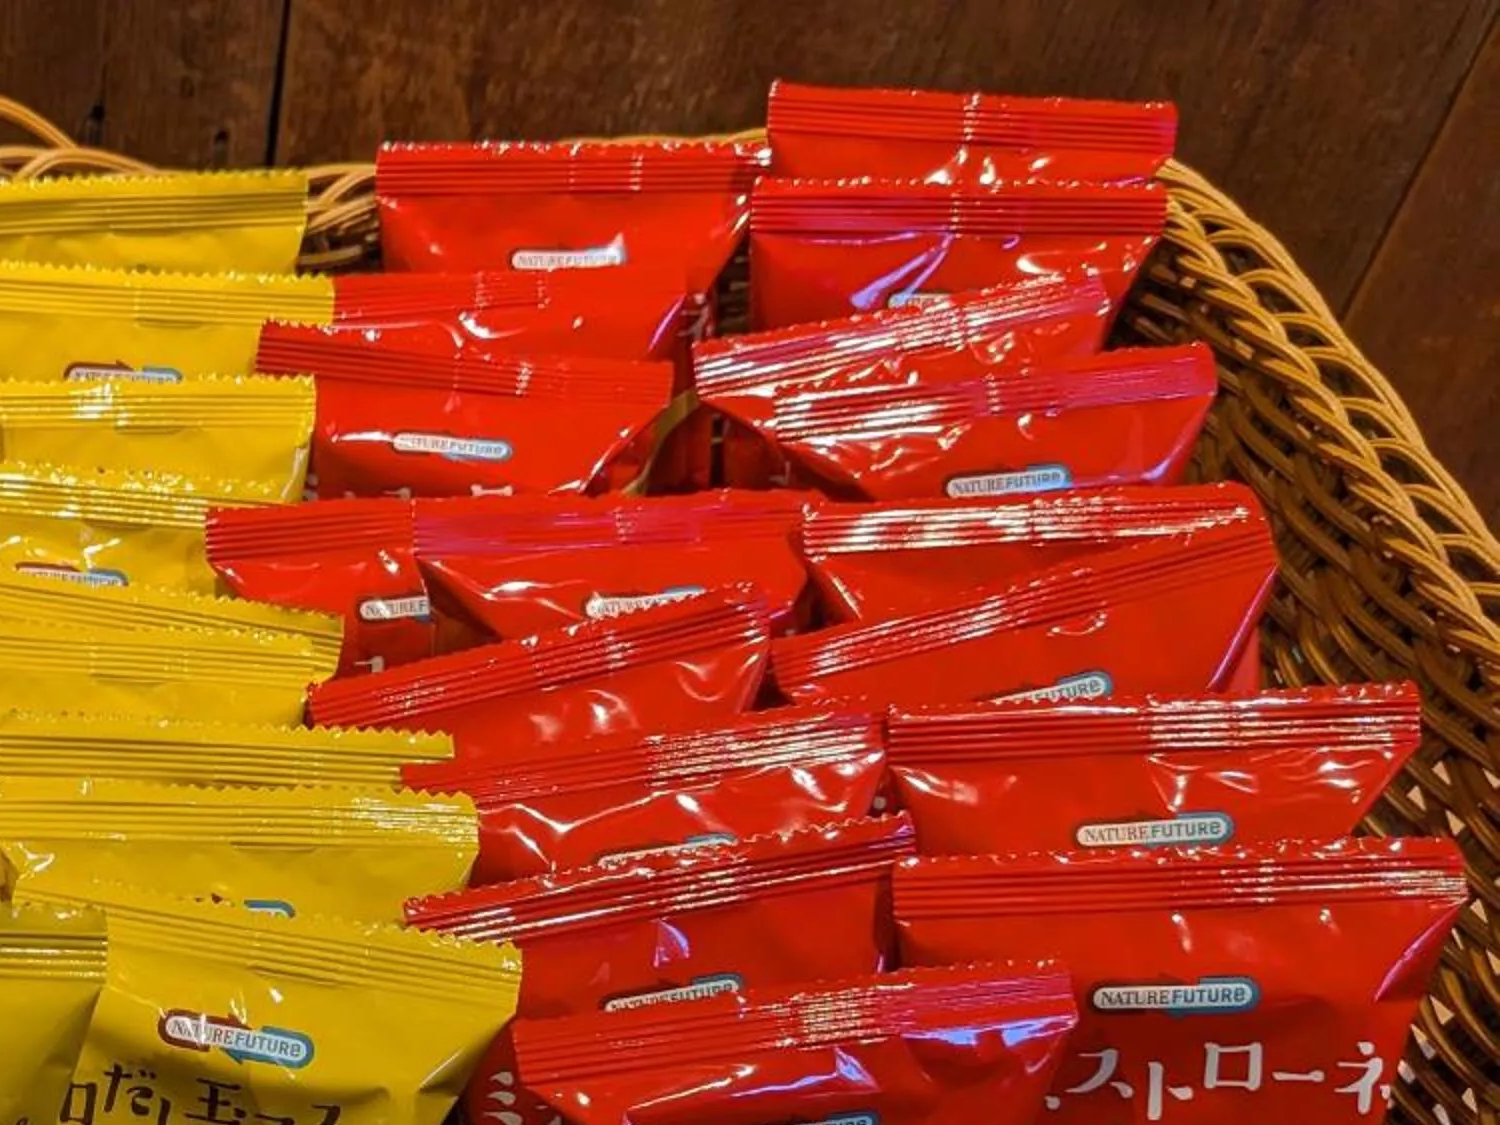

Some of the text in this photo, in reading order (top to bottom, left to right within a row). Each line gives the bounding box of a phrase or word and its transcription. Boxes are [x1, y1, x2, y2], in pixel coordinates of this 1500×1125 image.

[1046, 1041, 1396, 1121] ストローネ
